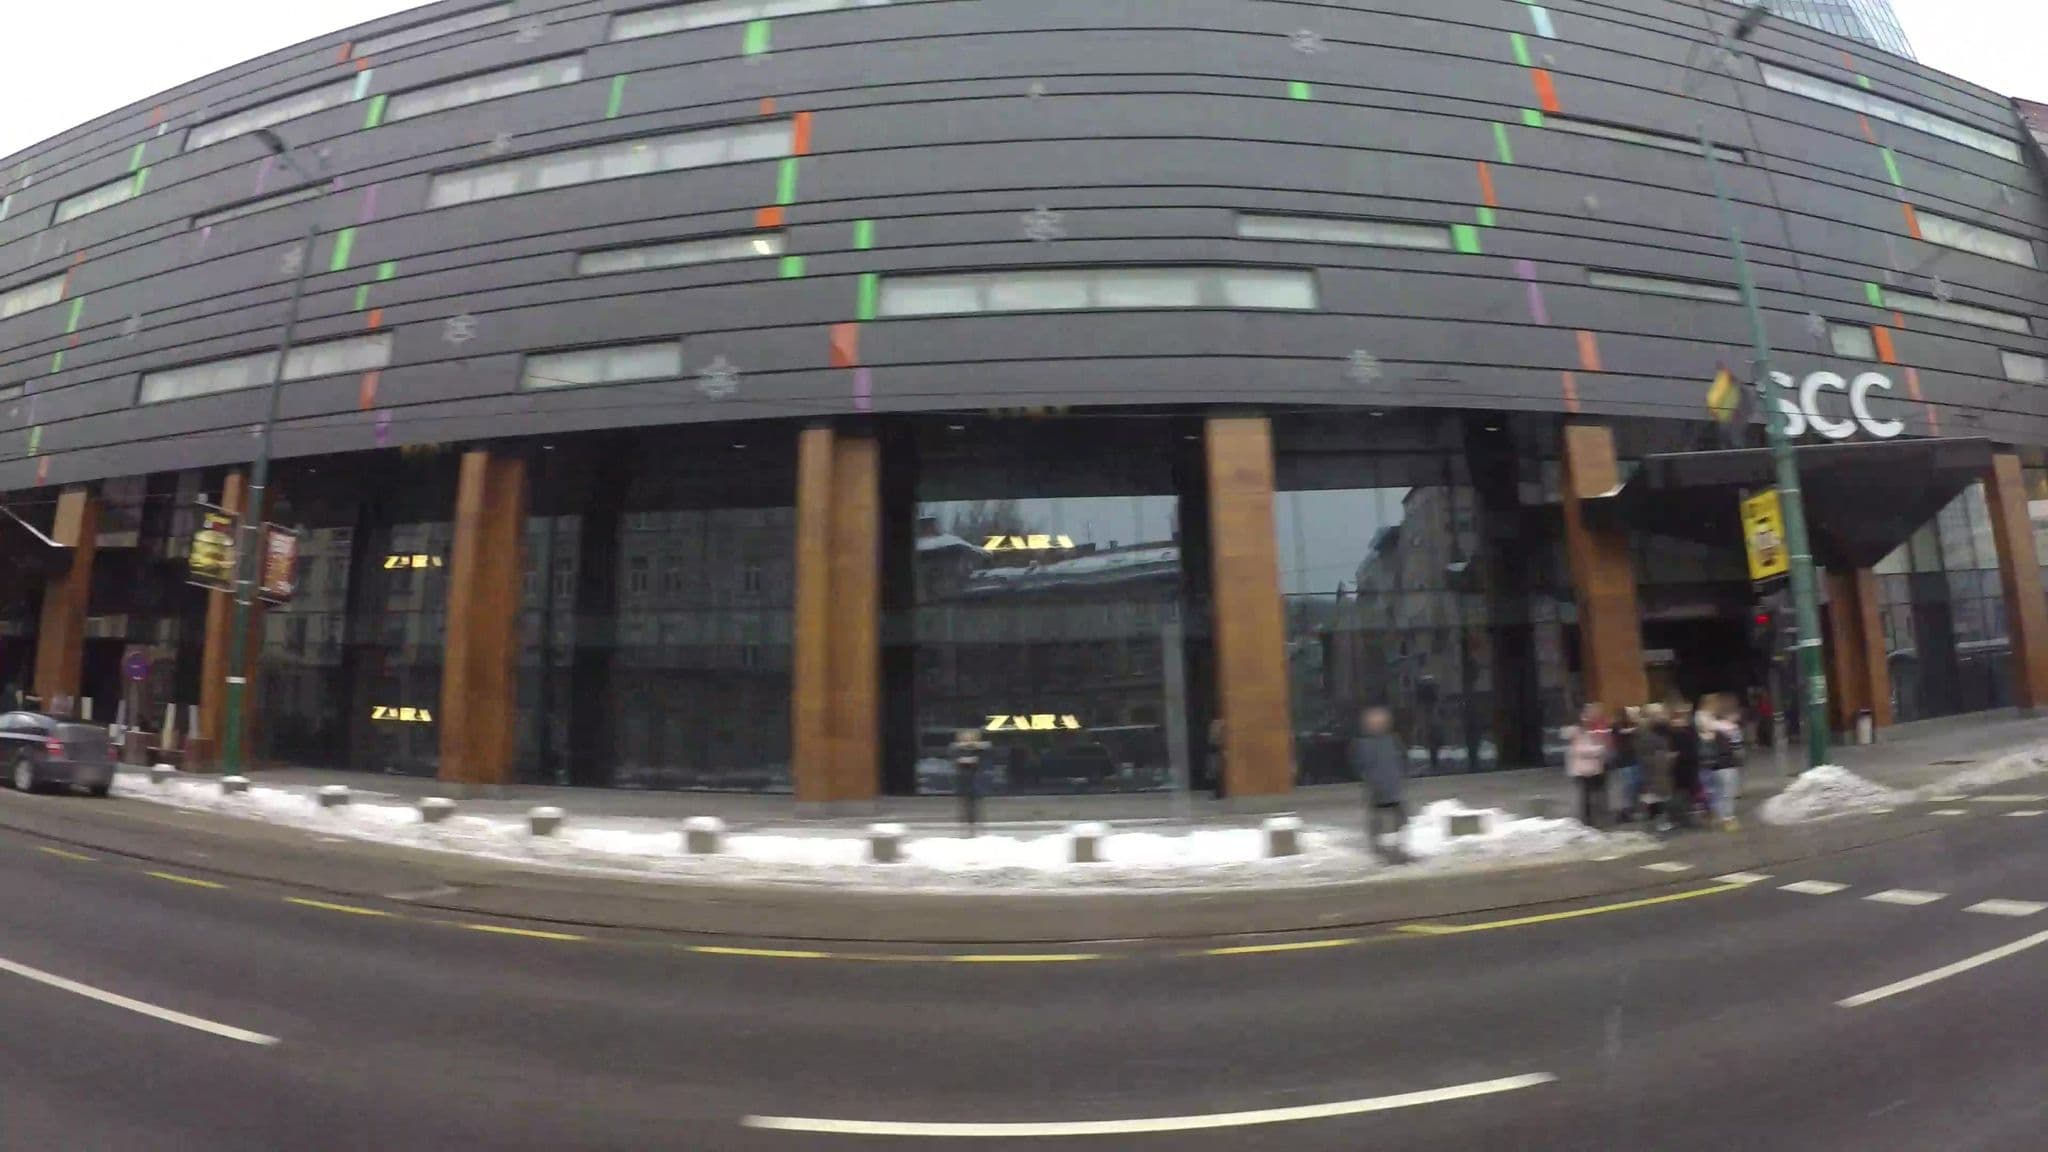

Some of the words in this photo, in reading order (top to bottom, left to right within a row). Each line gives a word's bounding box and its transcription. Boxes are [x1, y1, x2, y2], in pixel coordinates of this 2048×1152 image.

[983, 534, 1075, 550] ZARA
[371, 705, 433, 722] ZARA
[985, 714, 1081, 731] ZARA
